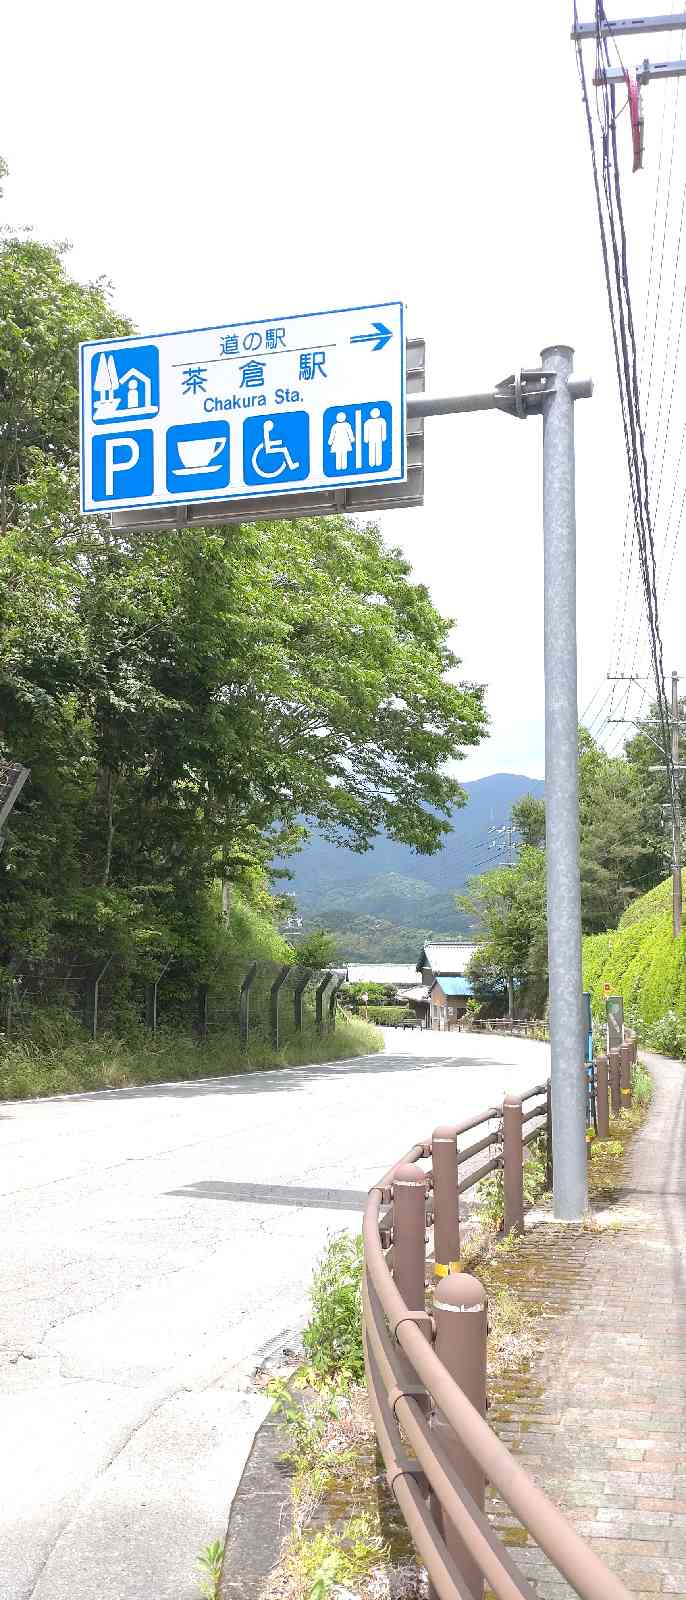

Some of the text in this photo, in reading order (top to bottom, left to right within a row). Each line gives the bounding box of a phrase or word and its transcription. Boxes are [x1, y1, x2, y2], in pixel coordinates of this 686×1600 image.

[219, 327, 287, 357] 道の駅
[203, 388, 304, 413] Chakura Sta.
[105, 438, 140, 496] P
